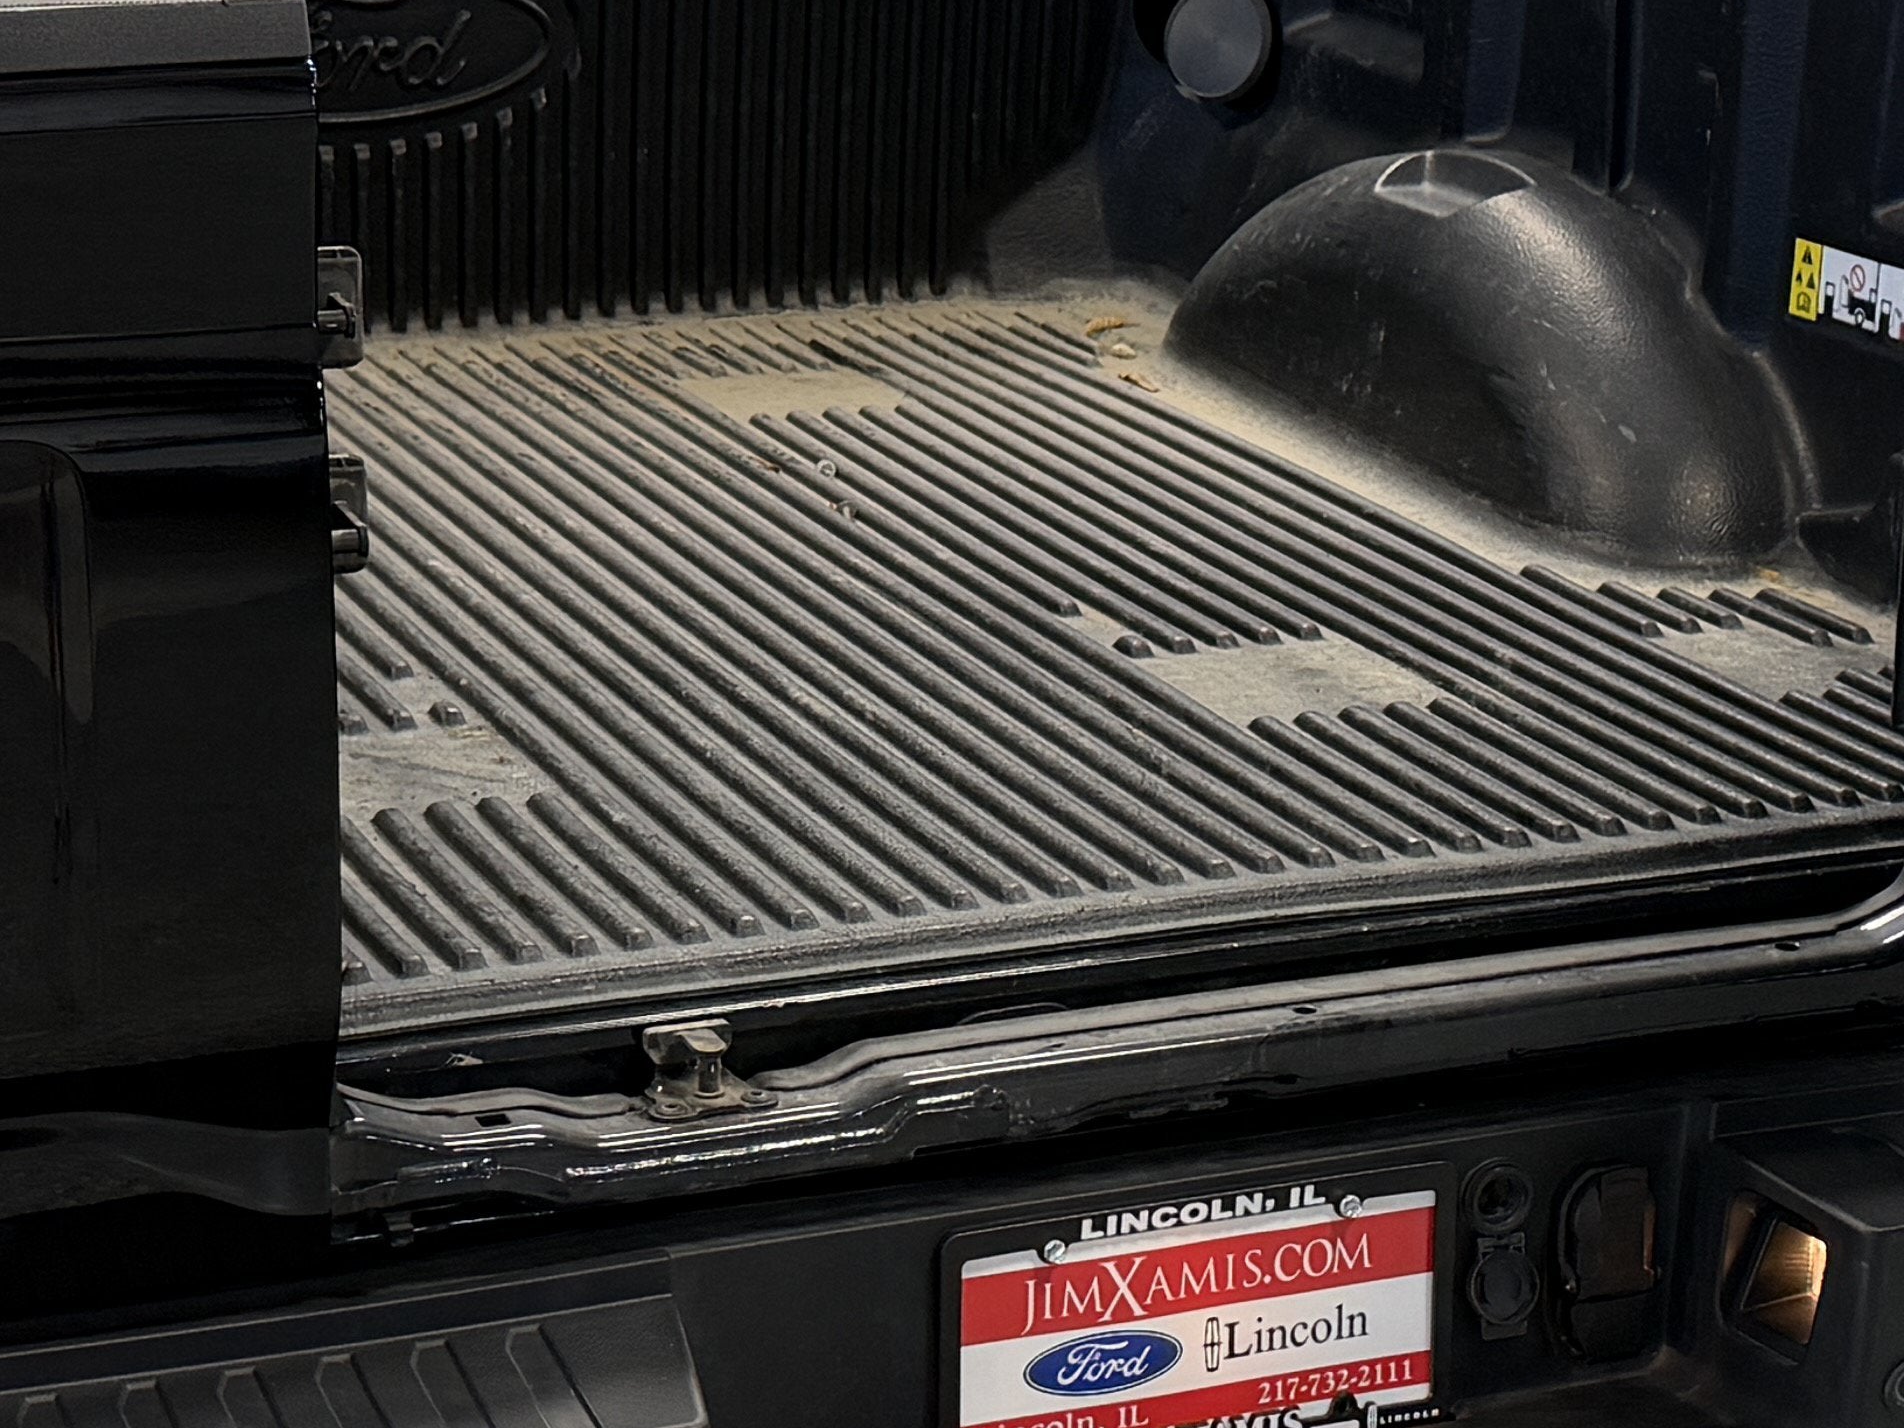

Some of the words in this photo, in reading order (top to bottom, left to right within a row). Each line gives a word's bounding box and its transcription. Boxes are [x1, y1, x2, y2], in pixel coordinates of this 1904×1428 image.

[1079, 1191, 1276, 1241] LINCOLN,
[1290, 1184, 1327, 1209] IL
[1021, 1232, 1373, 1336] JIMXAMIS.COM
[1223, 1303, 1369, 1360] Lincoln
[1056, 1342, 1149, 1386] Ford
[1257, 1359, 1414, 1406] 217-732-2111
[1117, 1404, 1149, 1428] IL
[1378, 1408, 1440, 1426] LINCOLN
